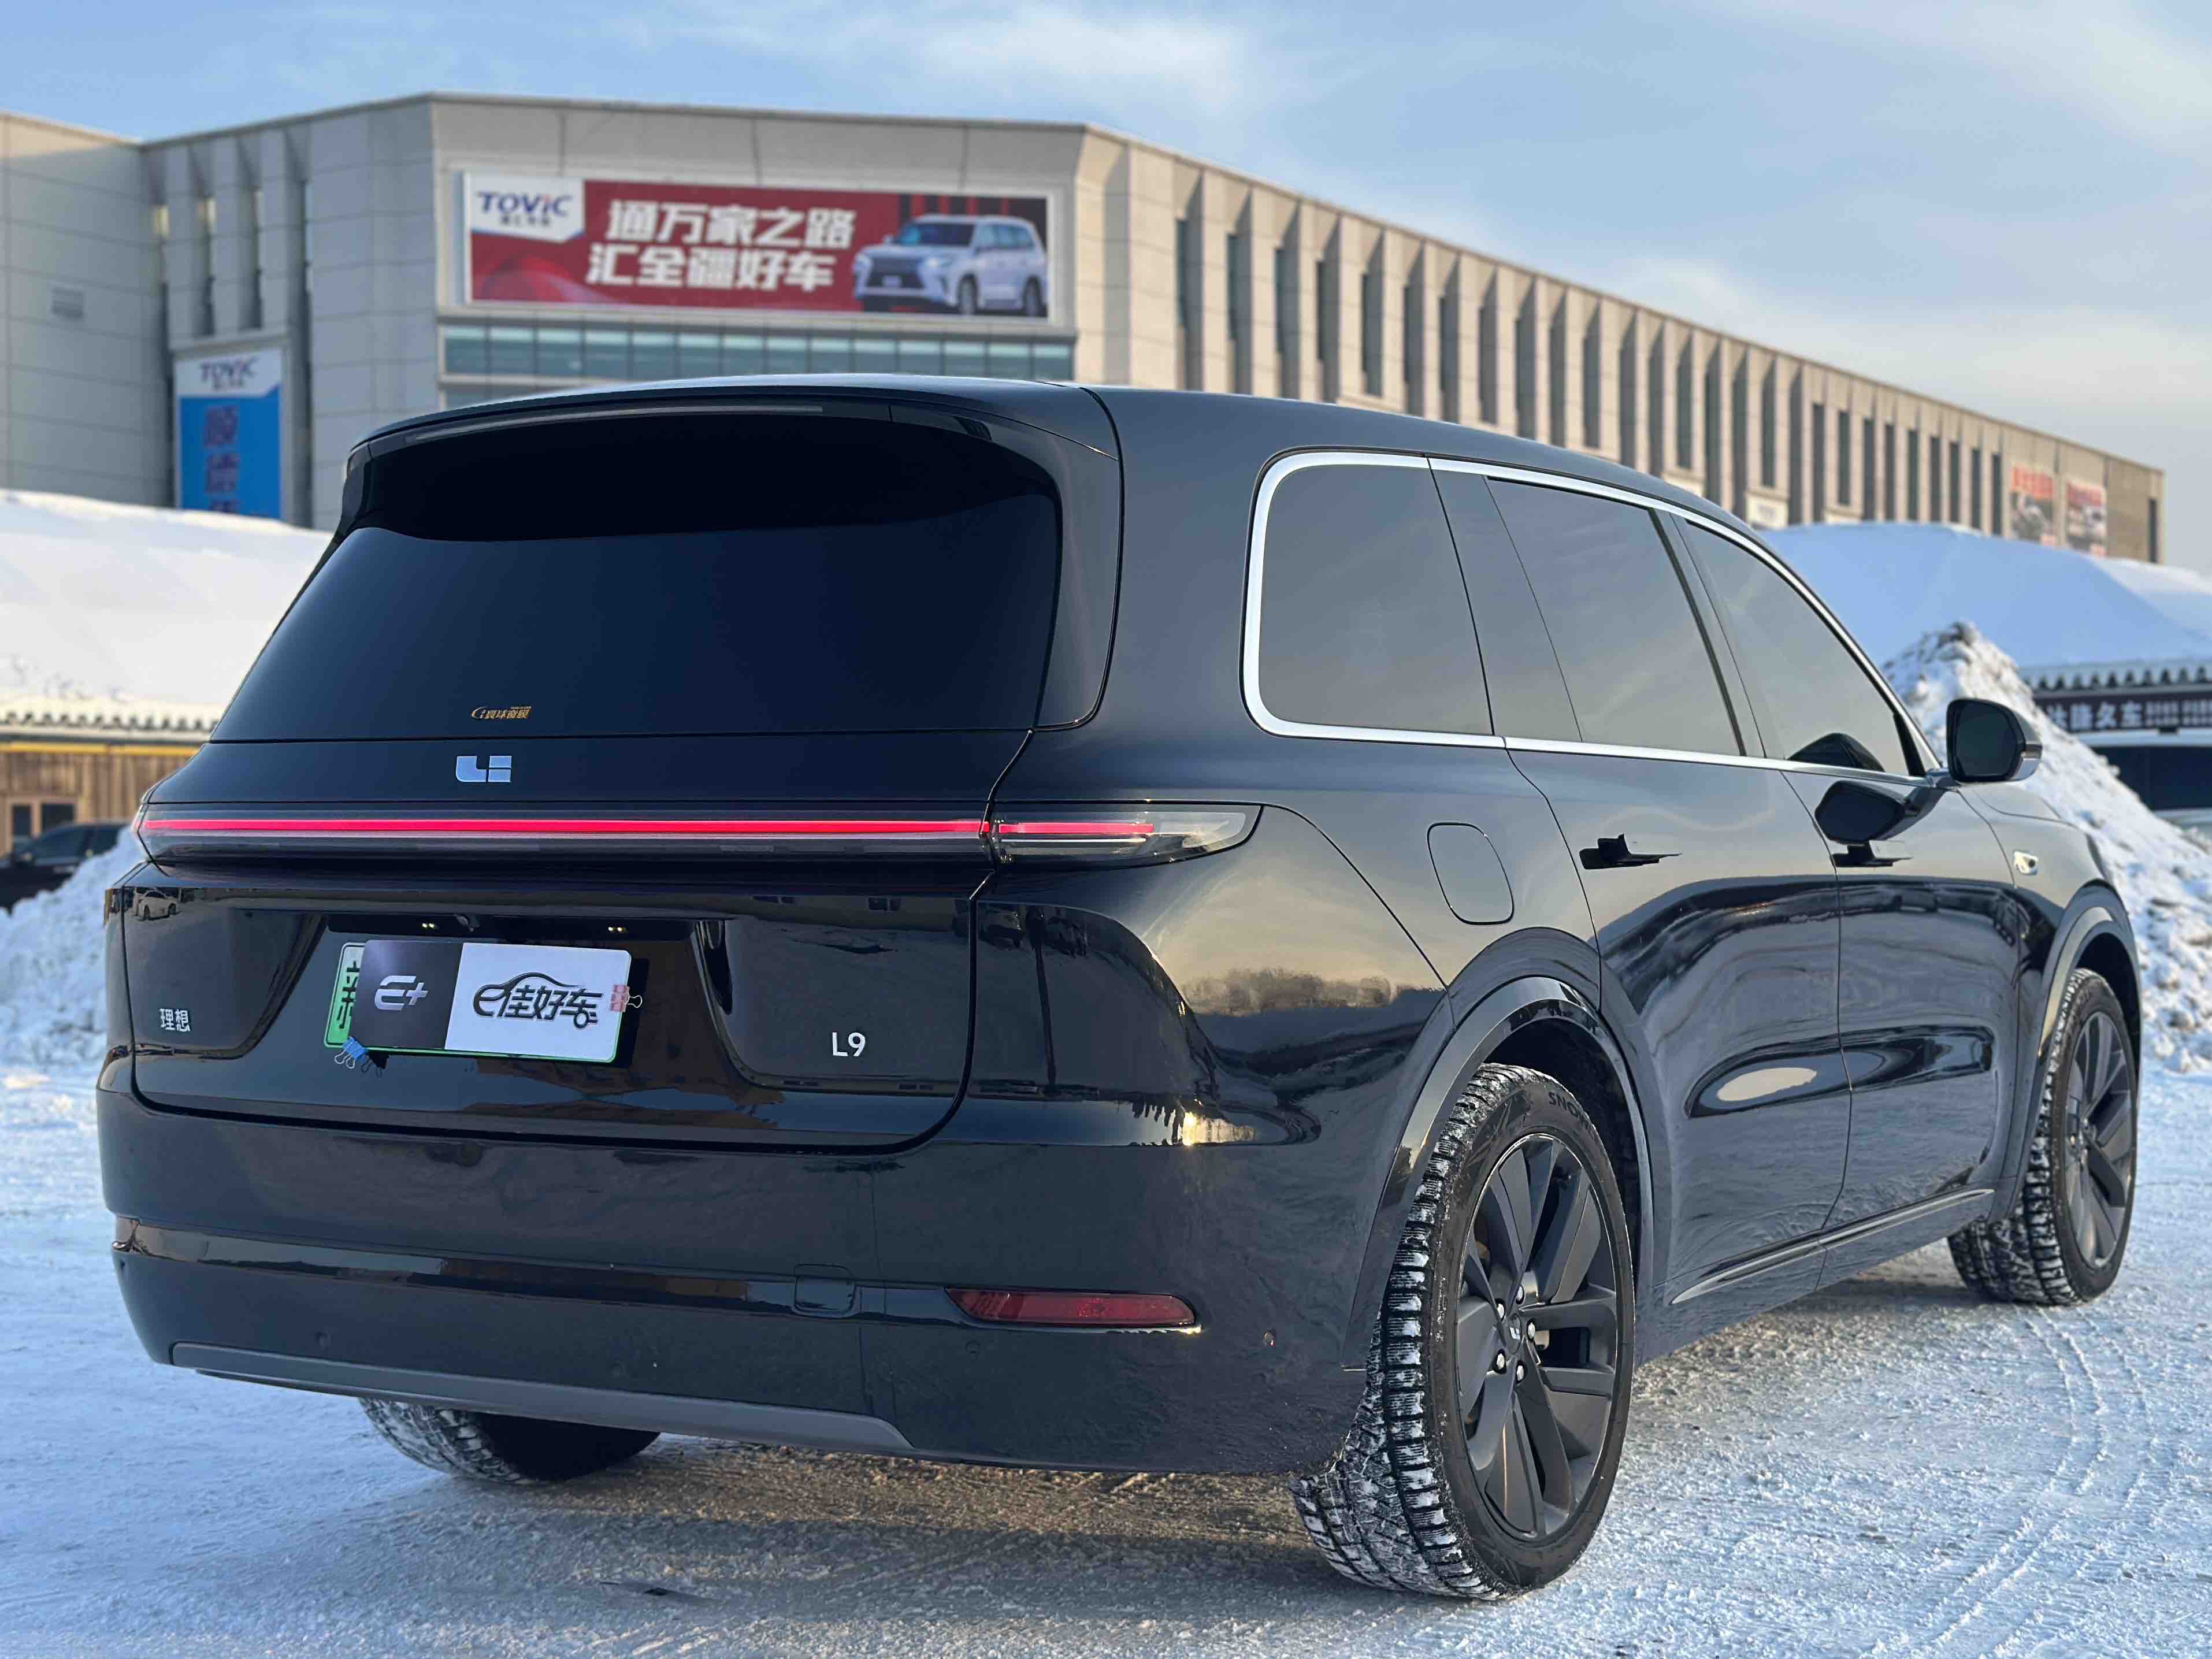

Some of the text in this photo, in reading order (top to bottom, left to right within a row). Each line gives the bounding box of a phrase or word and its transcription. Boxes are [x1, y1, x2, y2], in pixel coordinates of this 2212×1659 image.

[606, 200, 856, 249] 通万家之路
[586, 243, 836, 291] 汇全疆好车
[159, 1008, 191, 1032] 理想
[832, 1032, 866, 1056] L9
